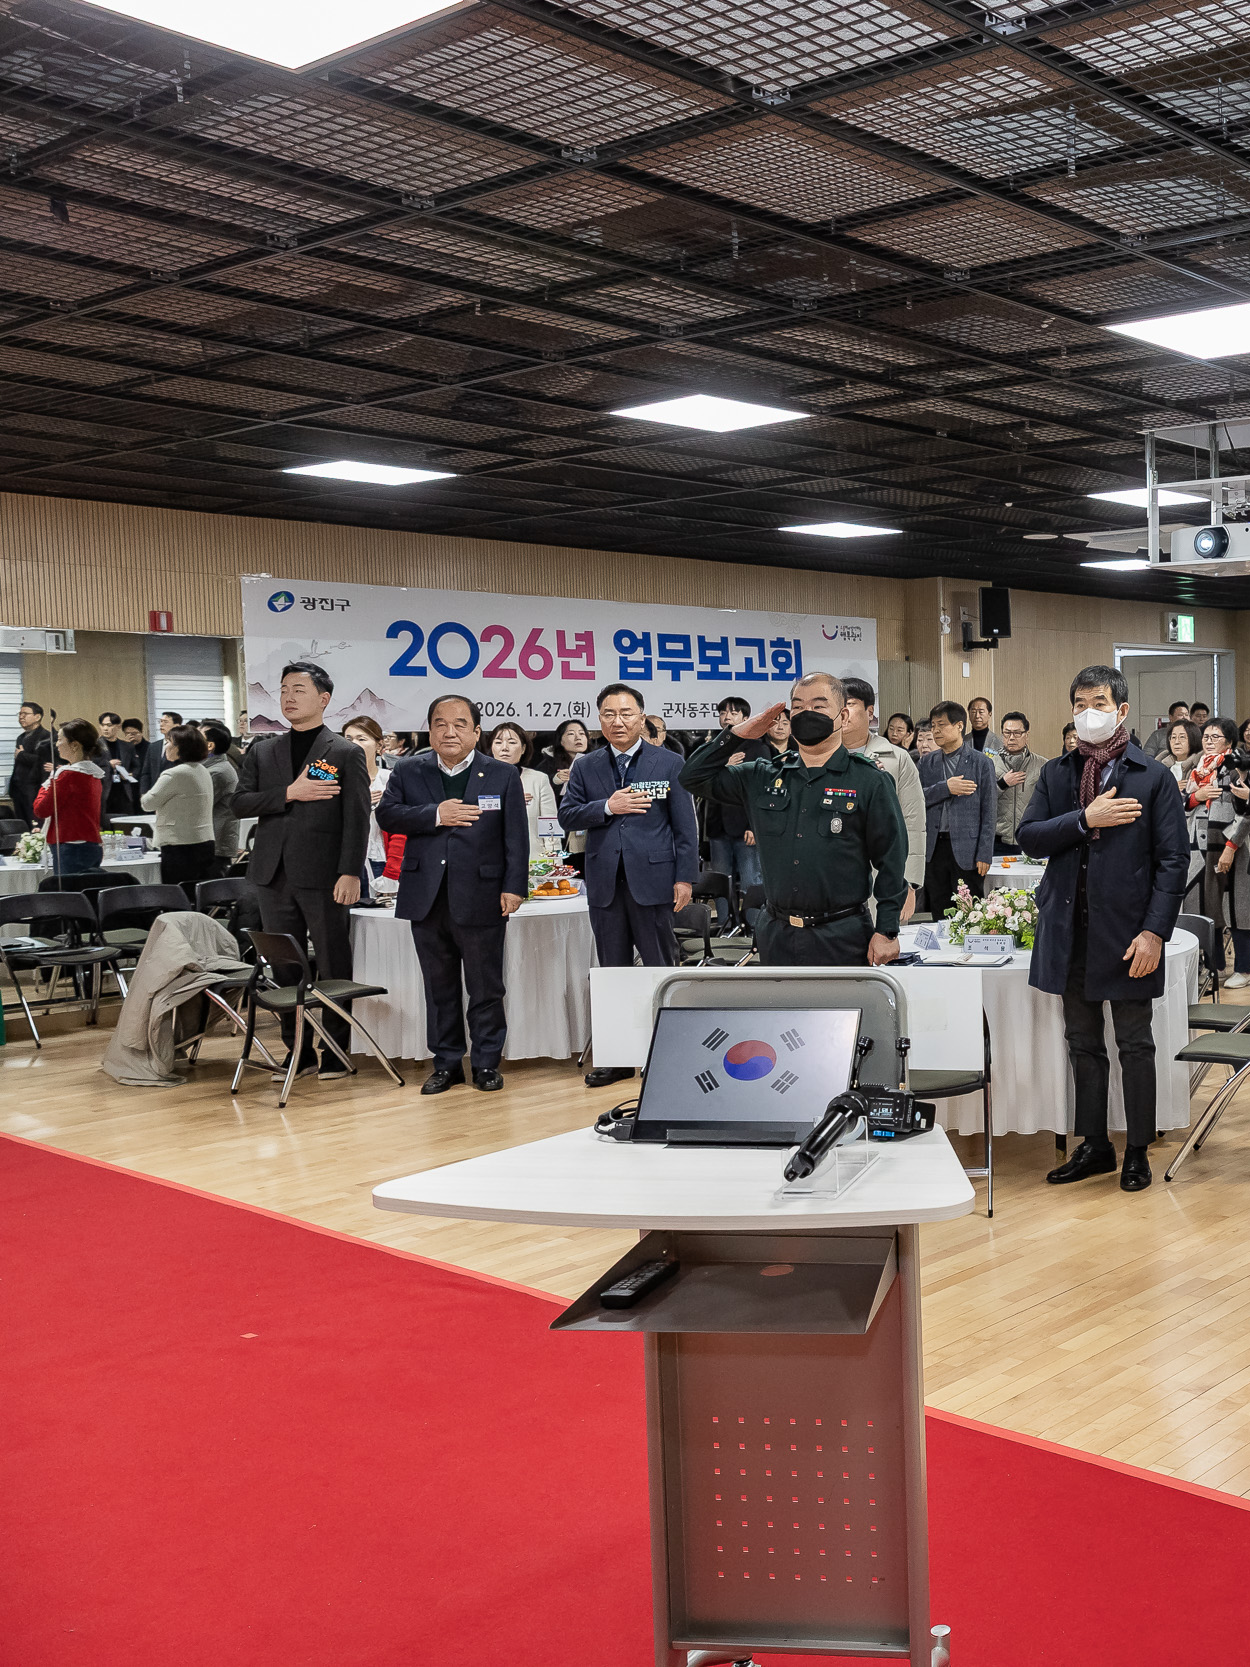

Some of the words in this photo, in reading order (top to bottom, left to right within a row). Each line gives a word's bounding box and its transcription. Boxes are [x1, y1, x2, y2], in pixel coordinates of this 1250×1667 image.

[299, 596, 352, 612] 광진구
[386, 619, 596, 681] 2026년
[613, 629, 804, 682] 업무보고회
[478, 701, 520, 717] 2026.
[527, 702, 539, 717] 1.
[543, 701, 591, 718] 27.(화)
[548, 822, 554, 831] 3
